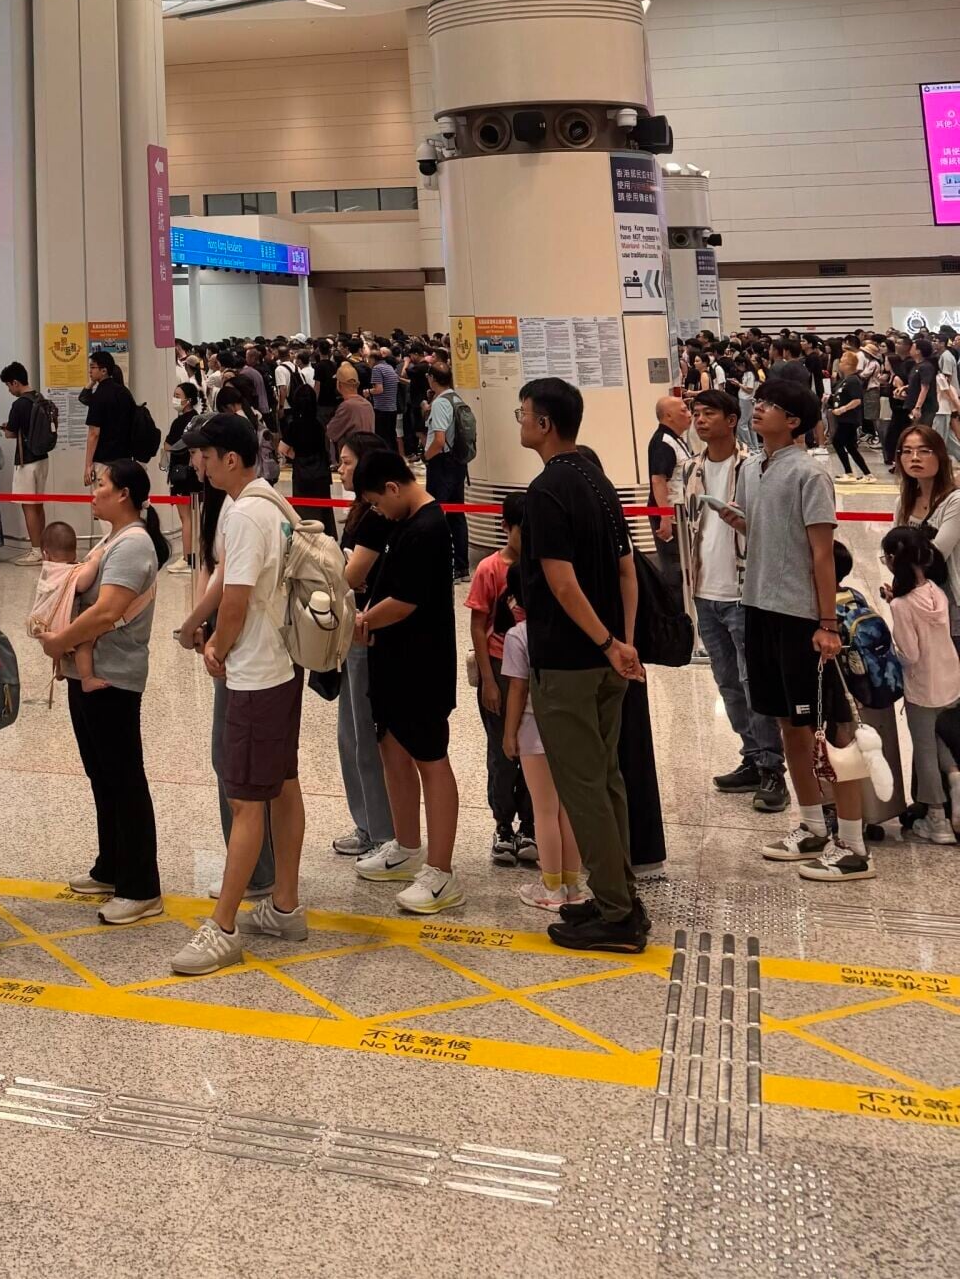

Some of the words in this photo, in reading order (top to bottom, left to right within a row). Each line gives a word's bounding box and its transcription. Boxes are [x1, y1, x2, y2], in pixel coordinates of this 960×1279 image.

[423, 924, 485, 937] Waiting
[491, 932, 514, 940] No
[841, 967, 915, 982] Waiting
[920, 976, 948, 985] No
[363, 1028, 472, 1052] 不准等候
[359, 1039, 386, 1050] No
[394, 1043, 467, 1061] Waiting
[857, 1089, 960, 1112] 不准等
[859, 1103, 891, 1114] No
[898, 1107, 960, 1123] Waiti
